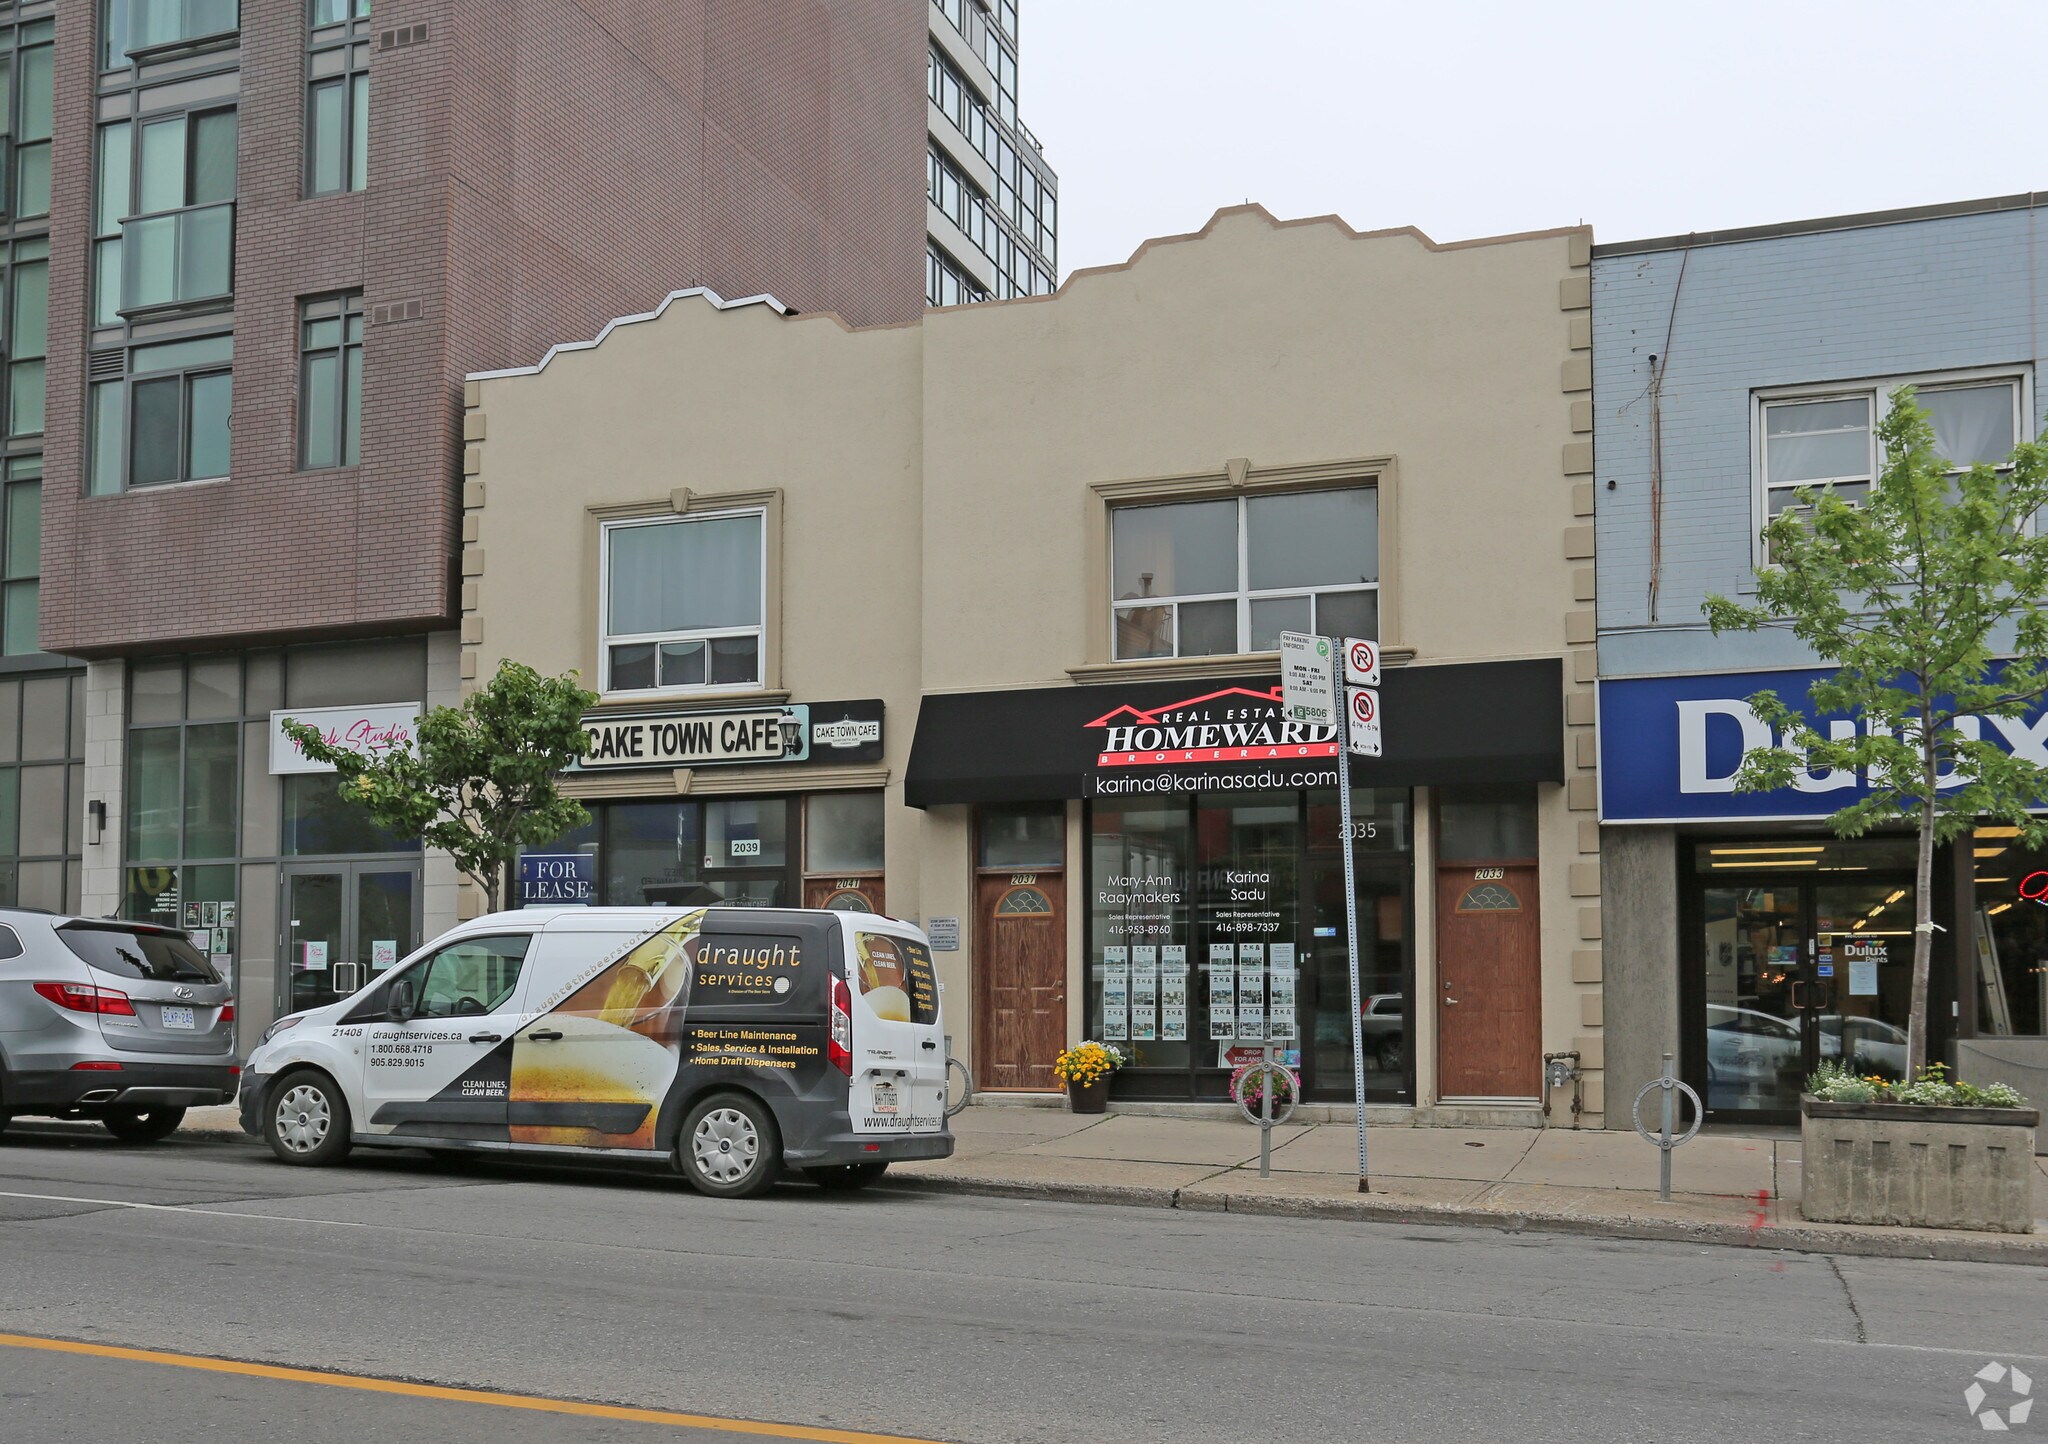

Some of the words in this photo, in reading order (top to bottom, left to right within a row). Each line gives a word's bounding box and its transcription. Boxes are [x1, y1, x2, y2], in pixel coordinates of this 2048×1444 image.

[1283, 642, 1304, 650] ENFORCED
[1162, 711, 1211, 724] REAL
[1306, 707, 1327, 717] 5806
[346, 719, 408, 750] Studio
[816, 726, 834, 738] CAKE
[836, 726, 856, 736] TOWN
[858, 724, 876, 736] CAFE
[588, 726, 644, 758] CAKE
[650, 721, 712, 756] TOWN
[720, 718, 779, 752] CAFE
[1102, 722, 1338, 753] HOMEWARD
[1101, 746, 1336, 764] BROKERAGE
[1096, 770, 1338, 794] karina@karinasadu.com
[734, 842, 758, 852] 2039
[536, 861, 577, 878] FOR
[1476, 868, 1503, 879] 2033
[1012, 874, 1036, 884] 2037
[1108, 875, 1171, 888] Mary-Ann
[1226, 871, 1269, 883] Karina
[524, 881, 589, 899] LEASE
[838, 880, 858, 888] 2041
[1099, 891, 1180, 905] Raaymakers
[1230, 888, 1266, 900] Sadu
[1108, 925, 1170, 934] 416-953-8960
[1216, 923, 1280, 932] 416-898-7337
[697, 943, 800, 969] draught
[872, 951, 886, 959] CLEAN
[1844, 944, 1888, 956] Dulux
[520, 916, 669, 1022] draught@thebeerstore.ca
[699, 972, 773, 986] services
[332, 1028, 362, 1036] 21408
[372, 1030, 462, 1041] draughtservices.ca
[698, 1030, 717, 1038] Beer
[720, 1030, 738, 1038] Line
[741, 1031, 796, 1040] Maintenance
[372, 1045, 432, 1054] 1.800.668.4718
[697, 1043, 722, 1052] Sales,
[724, 1044, 757, 1053] Service
[768, 1045, 818, 1055] Installation
[371, 1058, 424, 1067] 905.829.9015
[721, 1057, 742, 1065] Draft
[745, 1058, 796, 1069] Dispensers
[486, 1081, 508, 1089] LINES,
